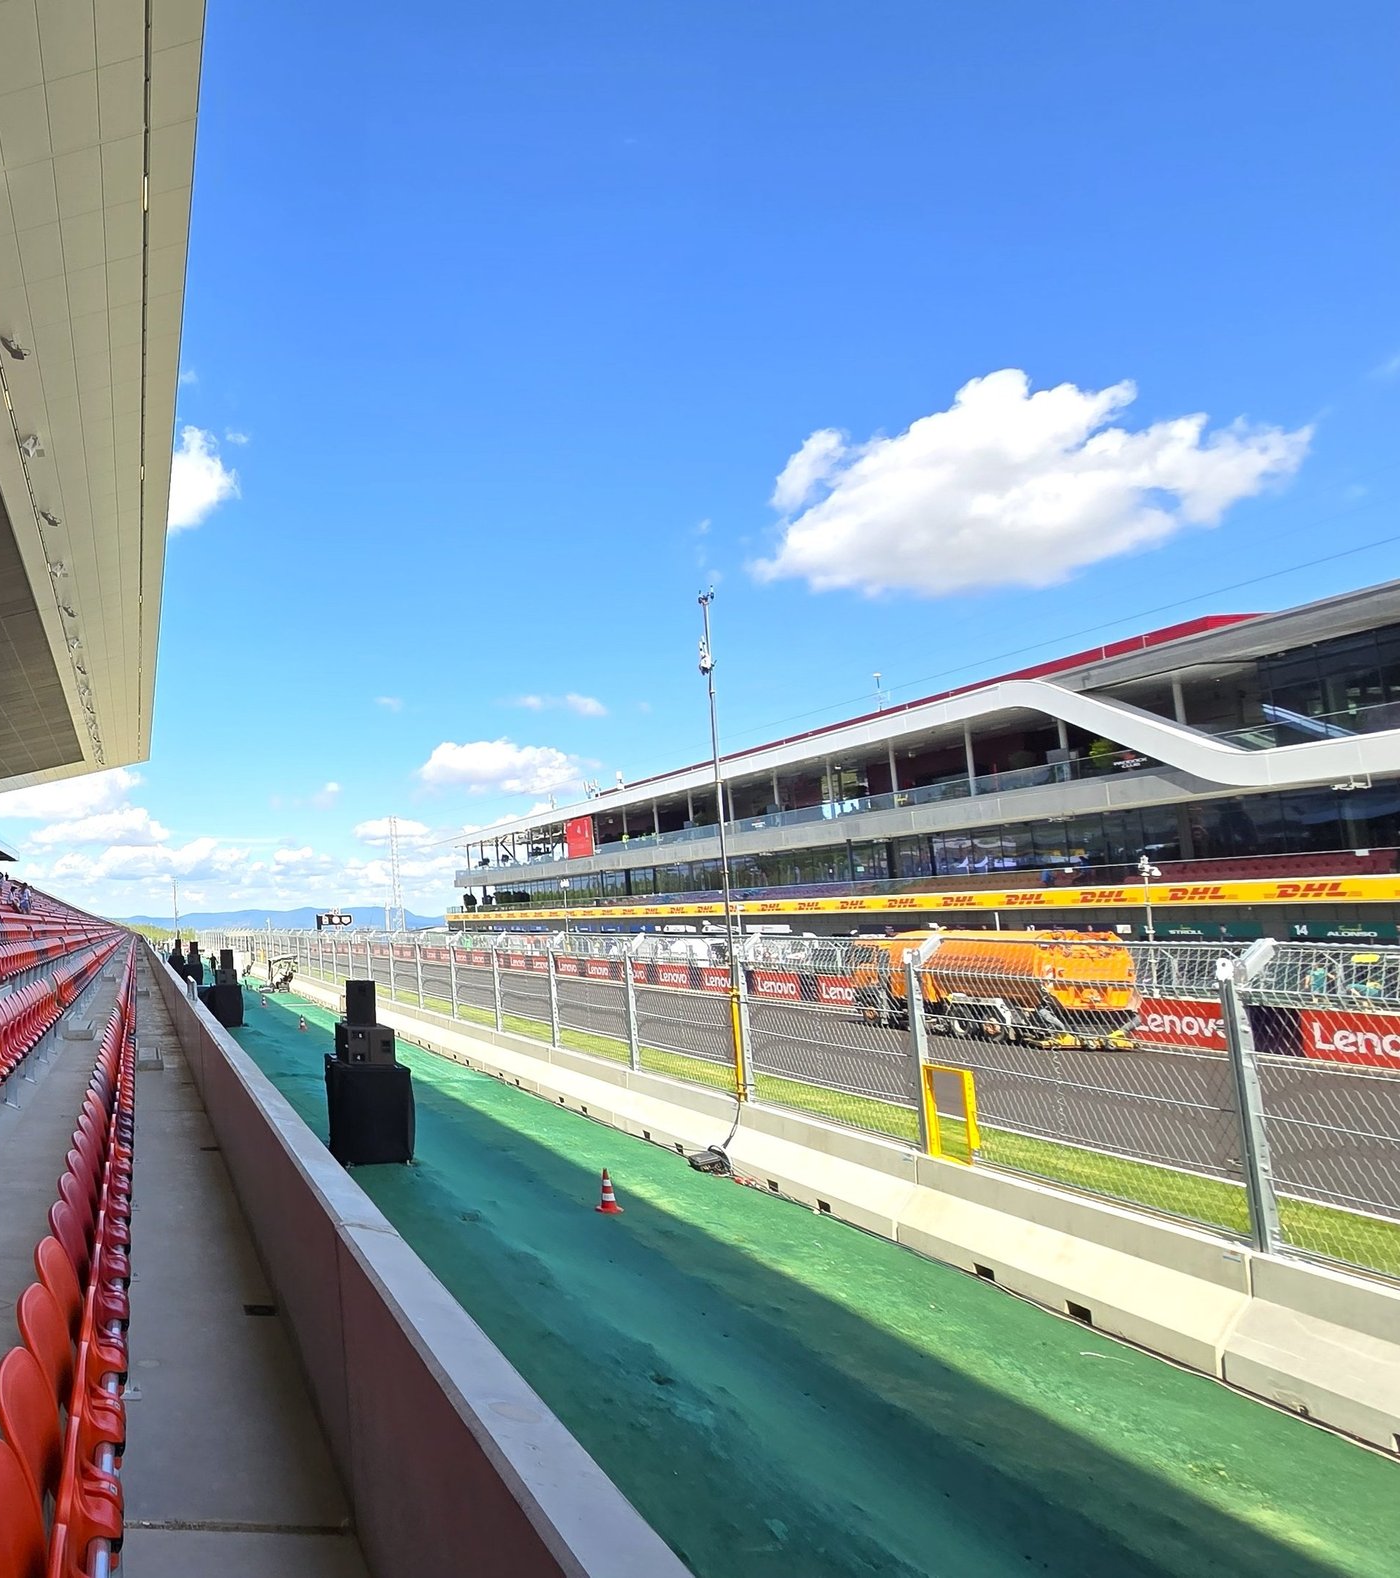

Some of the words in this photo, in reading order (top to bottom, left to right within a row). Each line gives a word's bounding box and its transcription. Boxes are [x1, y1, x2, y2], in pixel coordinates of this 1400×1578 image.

[1080, 890, 1128, 903] DHL
[1168, 886, 1226, 901] DHL
[1276, 882, 1349, 898] DHL
[839, 900, 866, 909] DHL
[887, 898, 917, 908] DHL
[941, 896, 977, 907] DHL
[1005, 893, 1046, 905] DHL
[797, 902, 822, 911] DHL
[1294, 924, 1309, 936] 14
[658, 968, 688, 984] Lenovo
[705, 972, 731, 988] Lenov
[757, 977, 797, 995] Lenovo
[821, 982, 856, 1001] Leno
